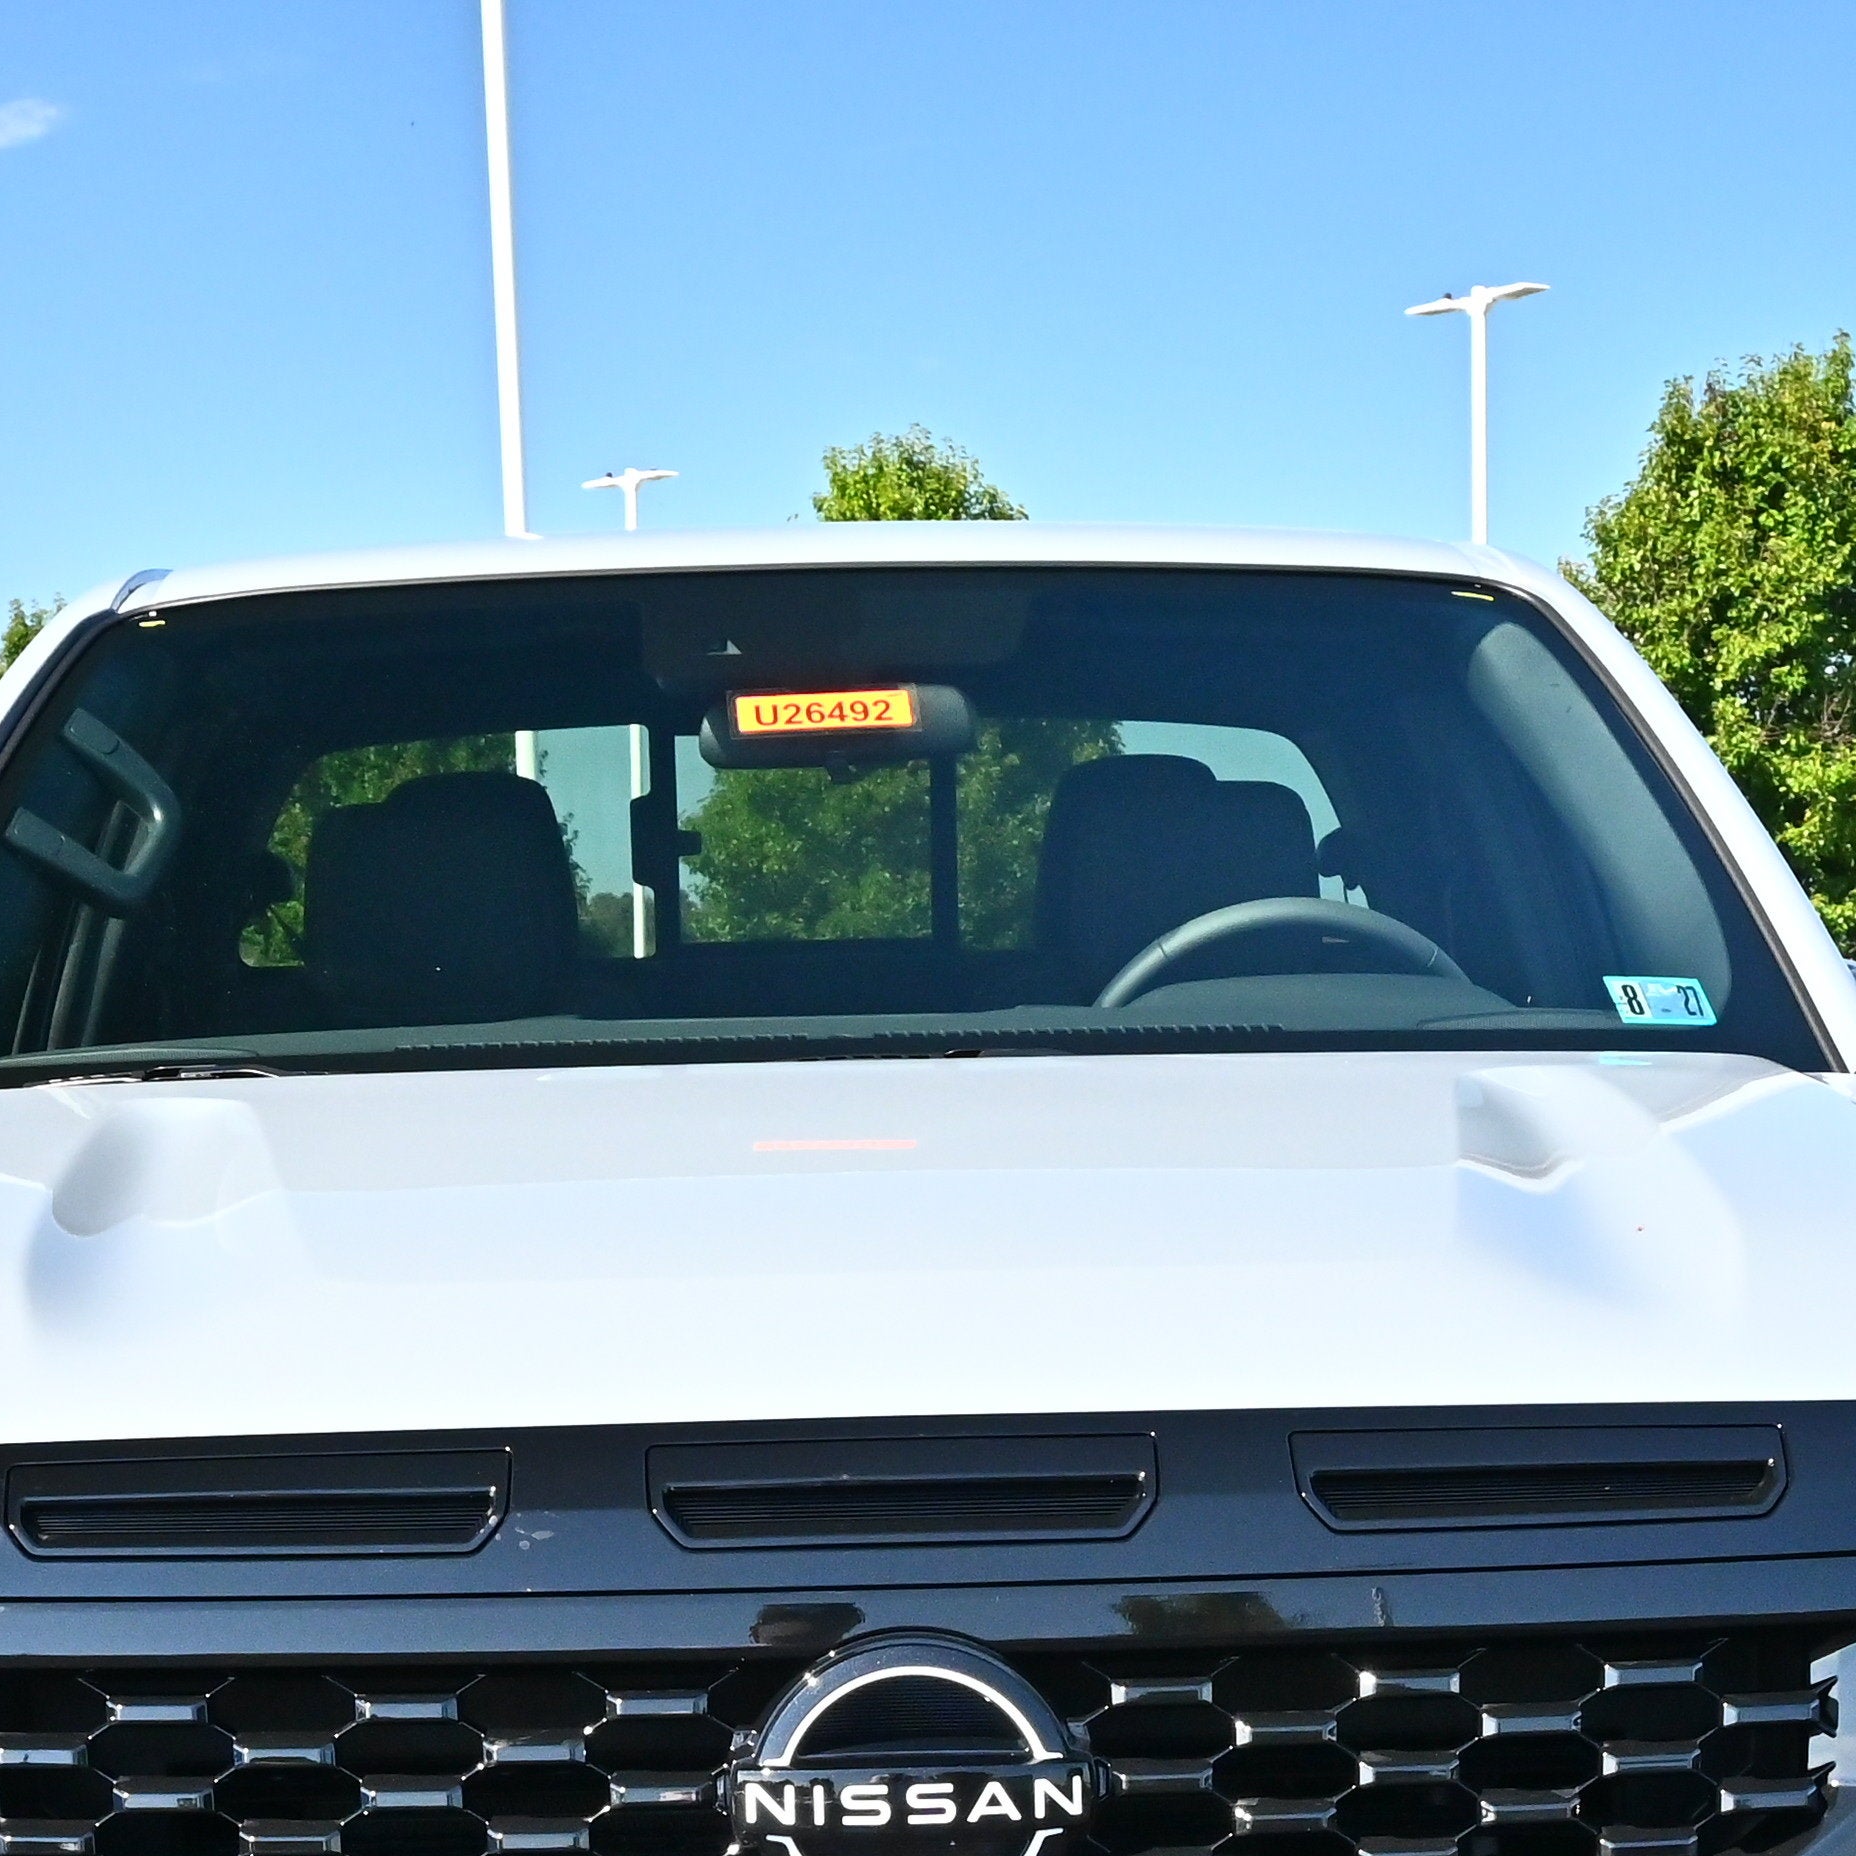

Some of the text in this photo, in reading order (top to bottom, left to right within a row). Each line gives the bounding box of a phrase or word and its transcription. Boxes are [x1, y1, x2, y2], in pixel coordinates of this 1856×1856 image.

[754, 699, 894, 726] U26492
[1621, 984, 1704, 1017] 8 27
[744, 1774, 1084, 1826] NISSAN
